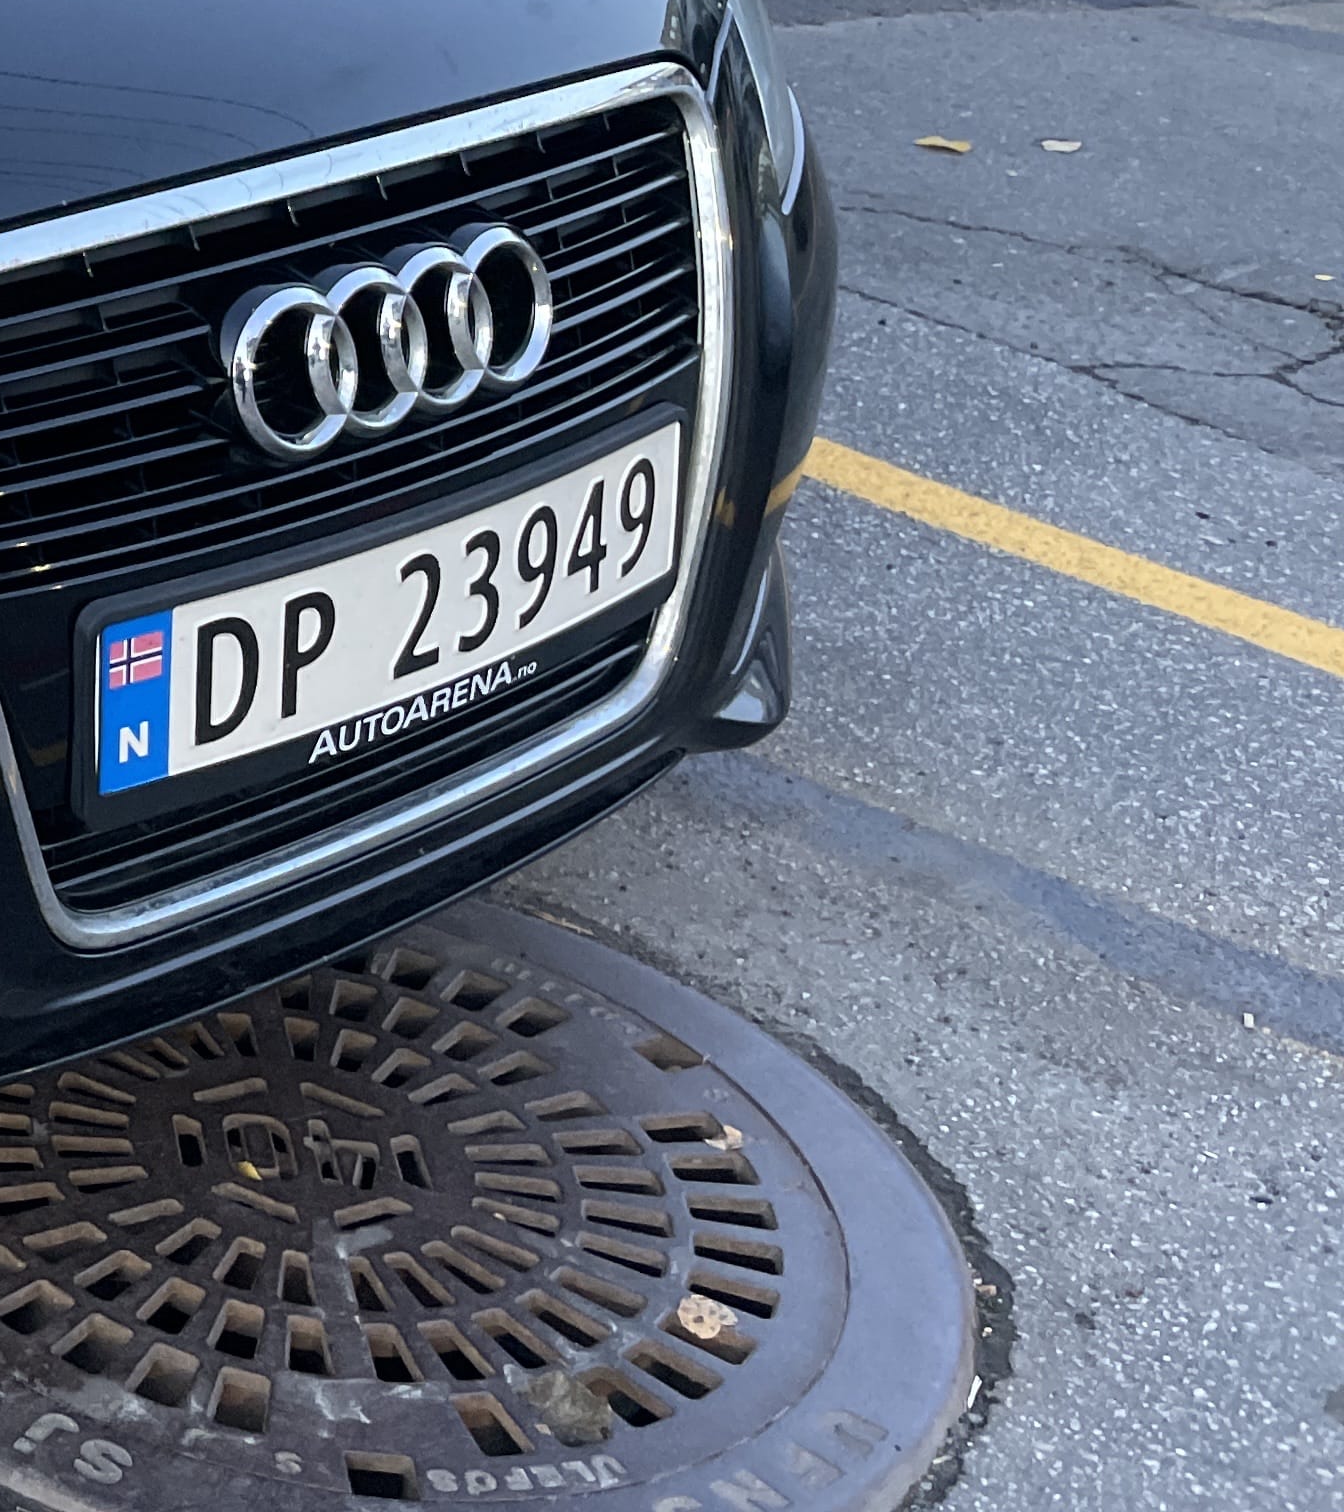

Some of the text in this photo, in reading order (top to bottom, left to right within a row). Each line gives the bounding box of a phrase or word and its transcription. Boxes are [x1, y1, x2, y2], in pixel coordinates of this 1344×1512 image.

[193, 455, 657, 748] DP 23949
[116, 719, 151, 764] N
